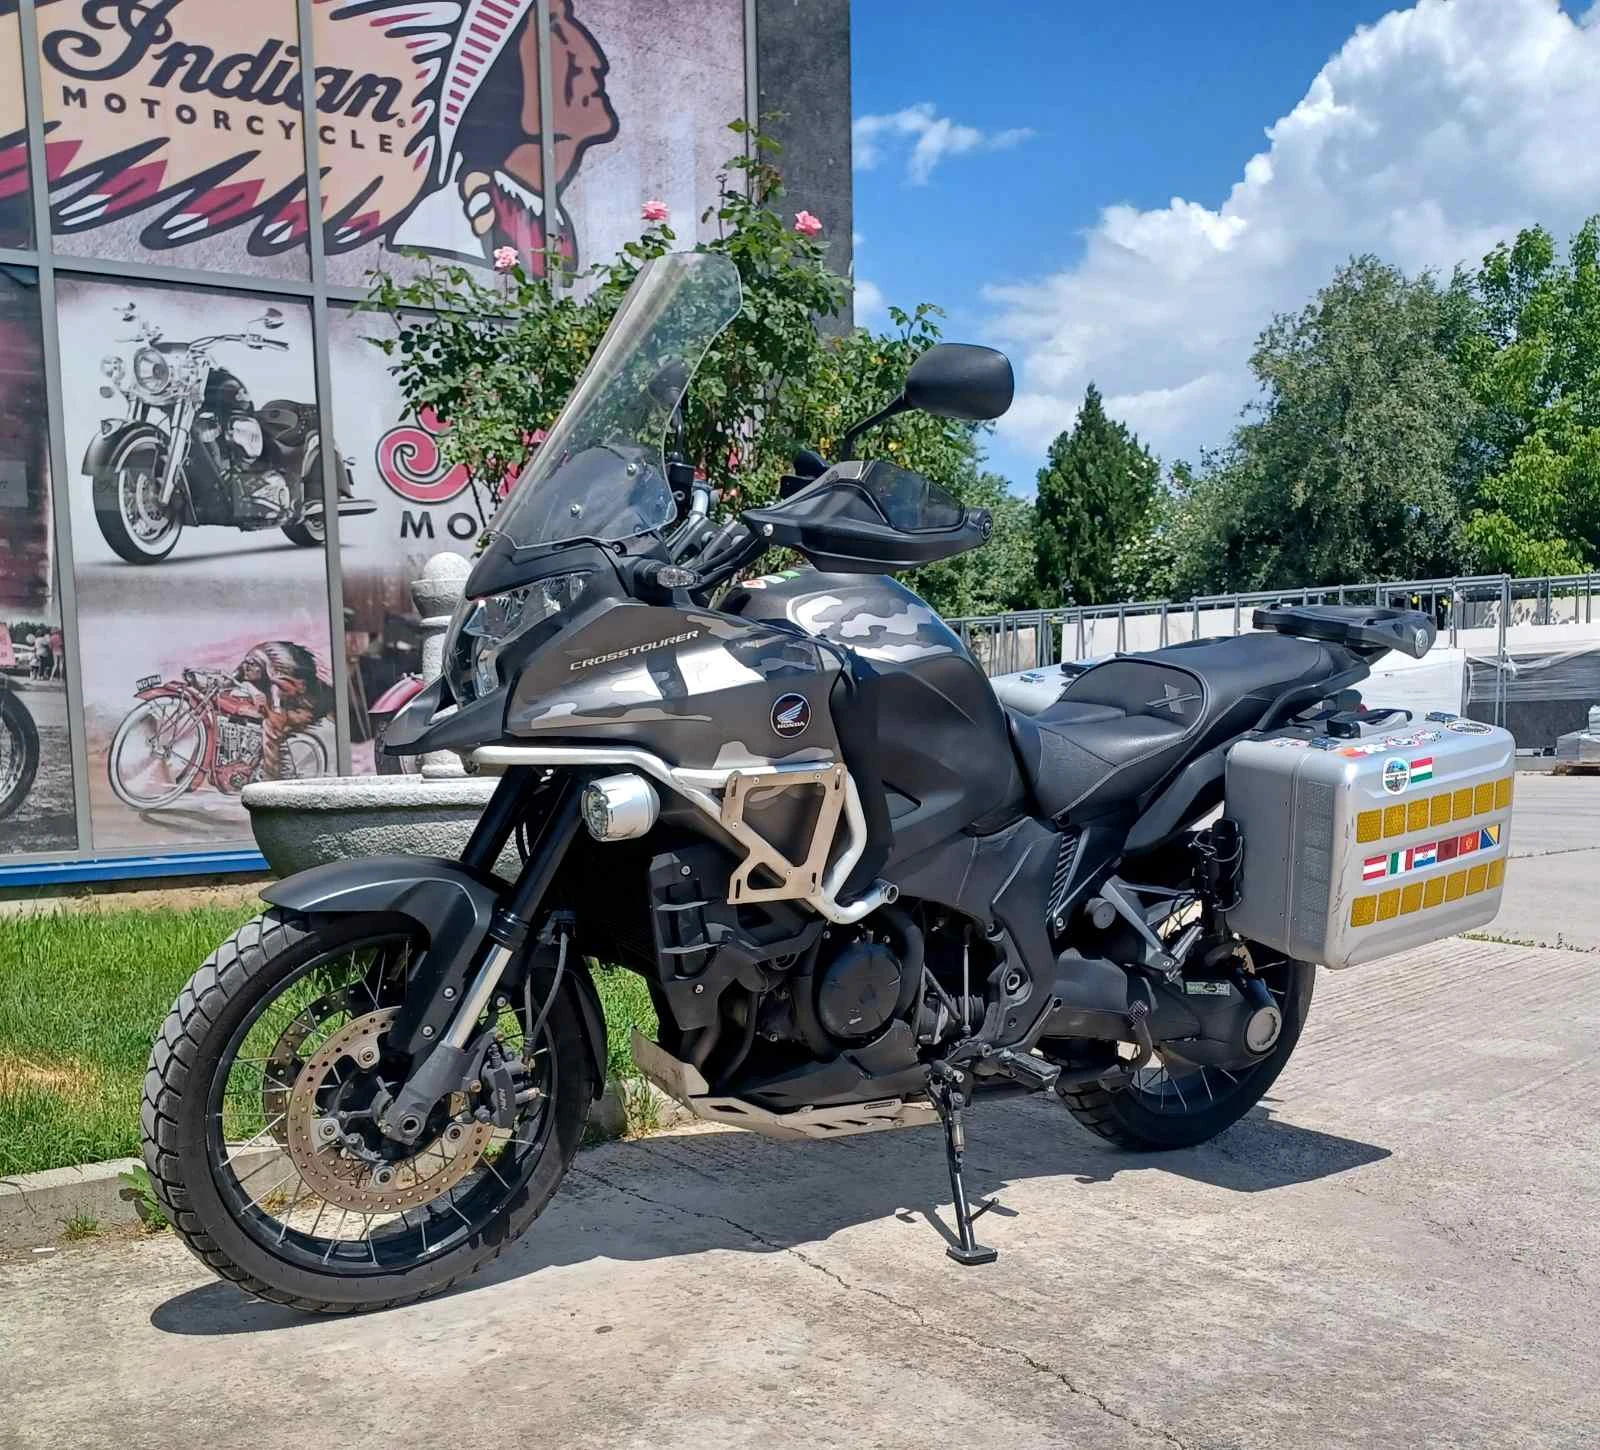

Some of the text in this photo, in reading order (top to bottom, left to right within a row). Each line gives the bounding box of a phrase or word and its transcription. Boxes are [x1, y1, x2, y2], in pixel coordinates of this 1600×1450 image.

[42, 0, 402, 123] Indian
[62, 86, 393, 154] MOTORCYCLE
[400, 511, 478, 541] MO
[570, 630, 699, 671] CROSSTOURER
[777, 721, 805, 729] HONDA
